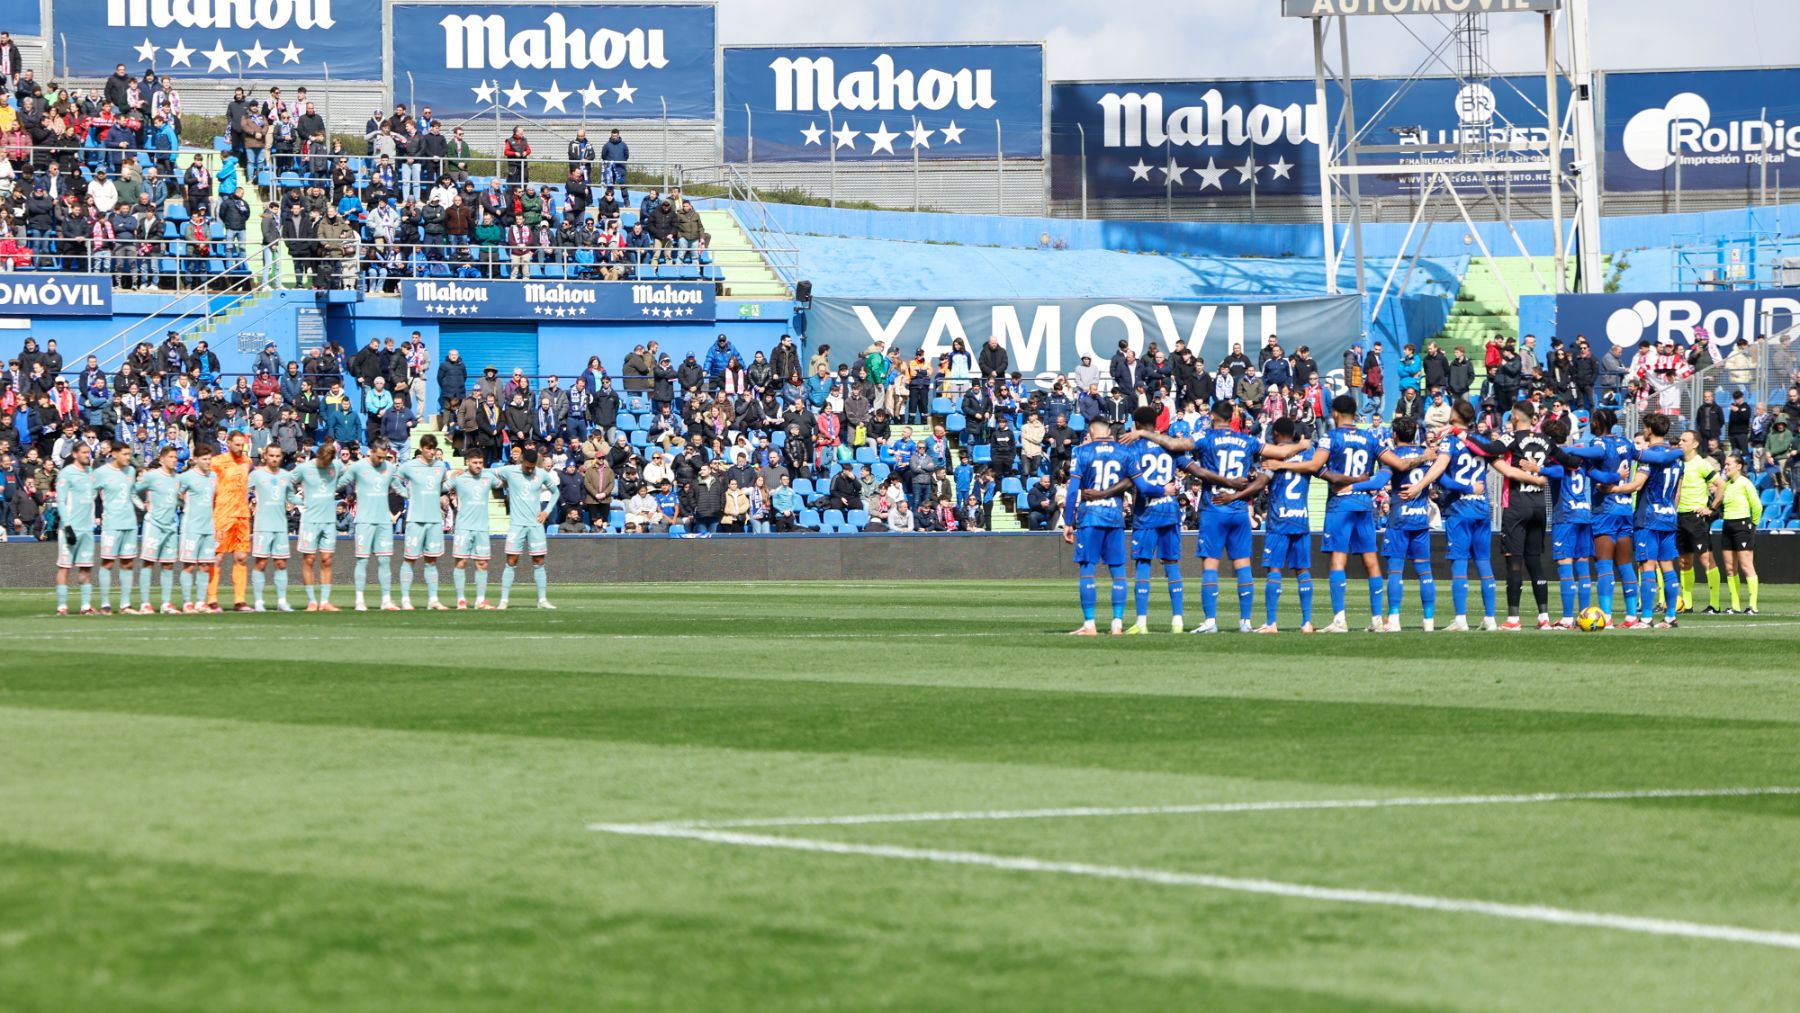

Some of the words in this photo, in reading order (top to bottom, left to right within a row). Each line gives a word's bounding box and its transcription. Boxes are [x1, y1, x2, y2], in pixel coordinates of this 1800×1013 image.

[439, 12, 669, 69] Mahou
[769, 54, 997, 112] Mahou
[1098, 89, 1320, 148] Mahou
[1681, 153, 1740, 166] Impresión
[415, 282, 488, 301] Mahou
[524, 283, 596, 304] Mahou
[632, 284, 703, 304] Mahou
[1092, 460, 1121, 492] 16
[1141, 450, 1173, 486] 29
[1217, 449, 1246, 480] 15
[1344, 447, 1369, 478] 18
[1455, 453, 1486, 487] 22
[1285, 469, 1302, 500] 2
[1571, 470, 1584, 495] 5
[1663, 467, 1680, 499] 11
